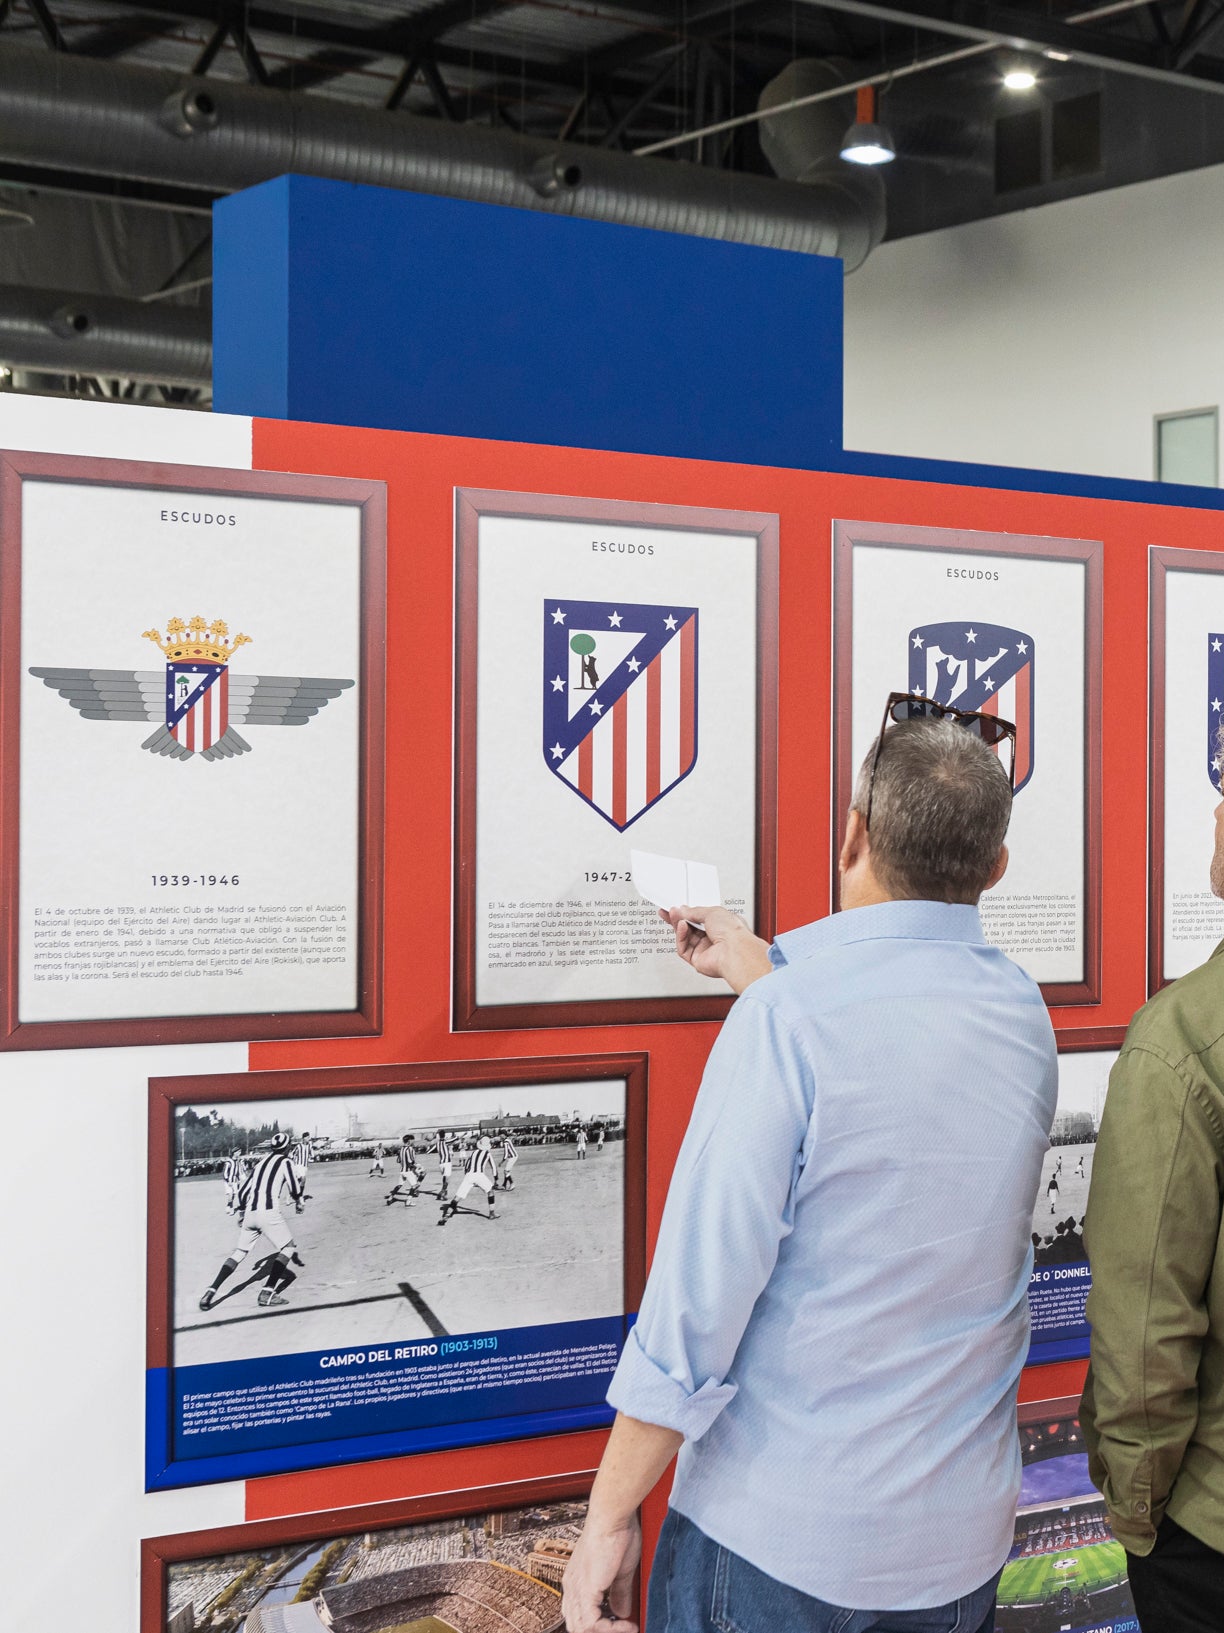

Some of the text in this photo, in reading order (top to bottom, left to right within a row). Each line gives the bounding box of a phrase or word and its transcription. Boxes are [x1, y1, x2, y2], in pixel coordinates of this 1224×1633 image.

[160, 510, 238, 527] ESCUDOS
[591, 540, 655, 556] ESCUDOS
[946, 568, 999, 581] ESCUDOS
[152, 874, 240, 886] 1939-1946
[584, 872, 632, 882] 1947-2
[597, 911, 610, 919] que
[628, 908, 657, 918] obligado
[34, 918, 70, 926] Nacional
[74, 918, 104, 928] (equipo
[172, 916, 190, 926] Aire)
[221, 916, 241, 926] lugar
[34, 940, 70, 948] vocablos
[488, 960, 527, 968] enmarcado
[580, 957, 604, 967] vigente
[140, 970, 169, 978] escudo
[203, 969, 224, 977] hasta
[320, 1337, 497, 1368] CAMPO DEL RETIRO (1903-1913)
